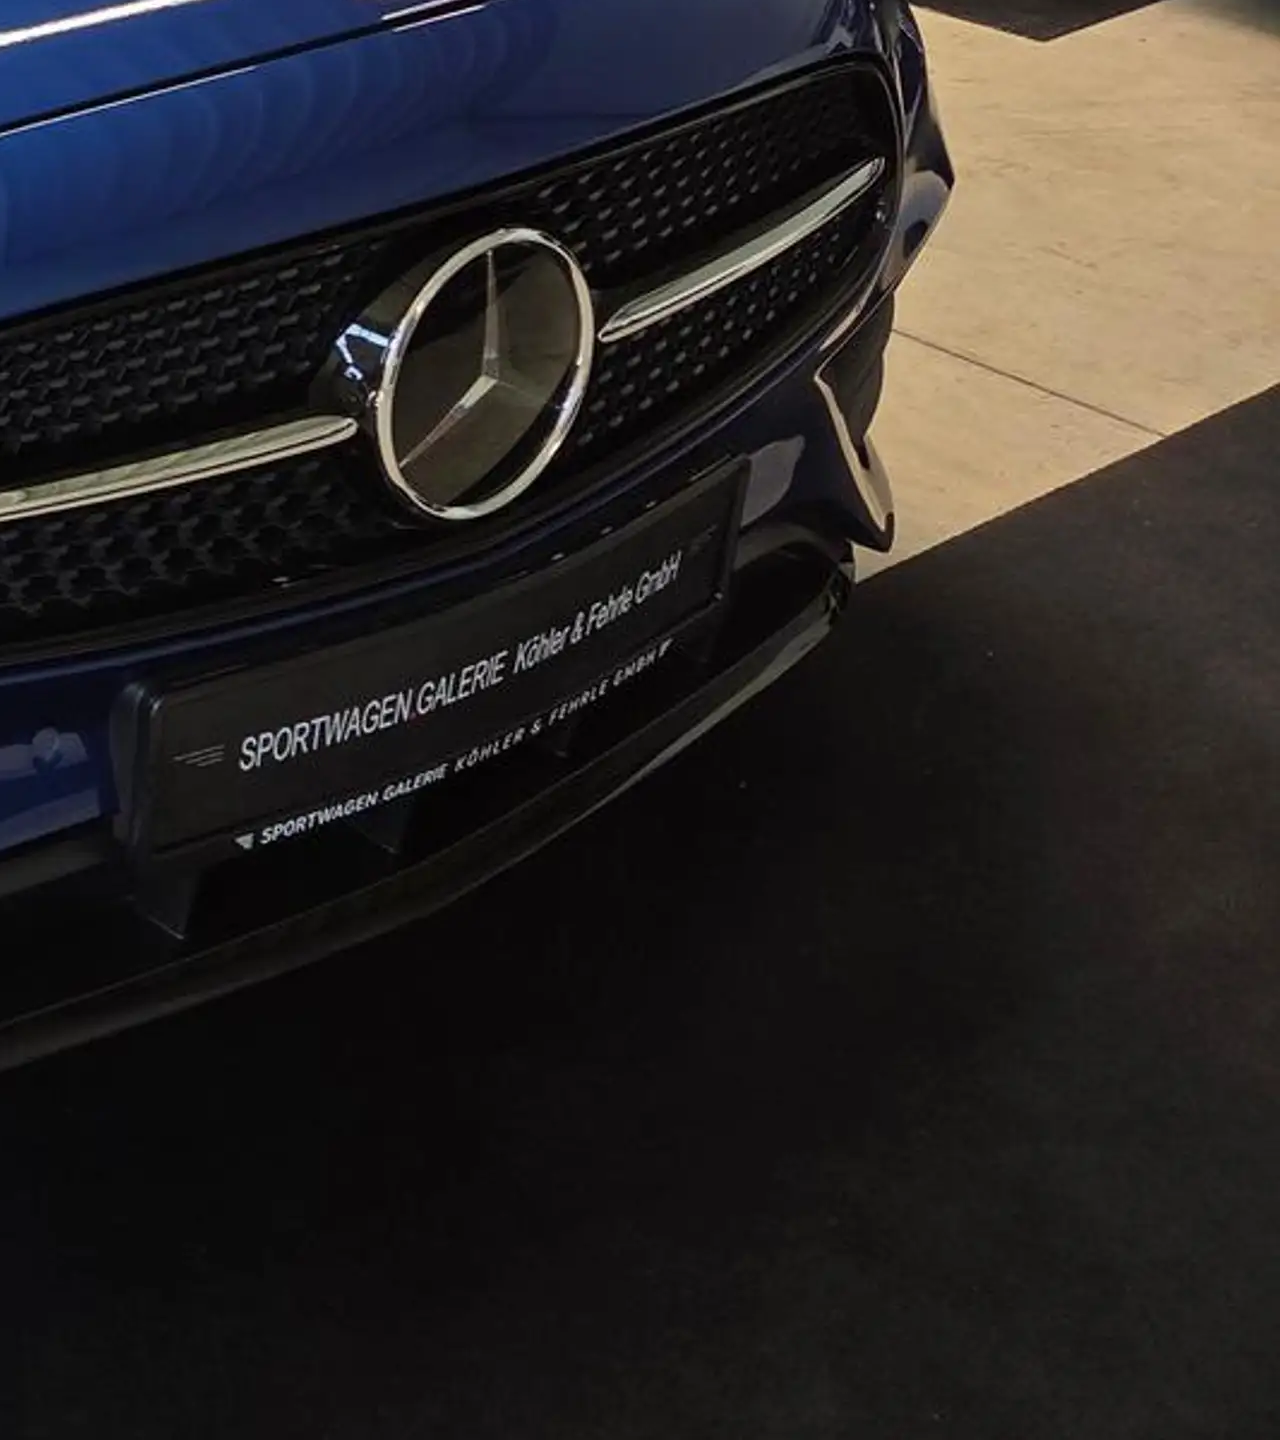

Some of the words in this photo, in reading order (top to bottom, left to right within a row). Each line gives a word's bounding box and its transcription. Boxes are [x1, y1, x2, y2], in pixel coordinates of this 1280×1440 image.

[513, 625, 570, 674] Köhler
[570, 612, 585, 644] &
[585, 586, 634, 636] Fehrle
[635, 550, 682, 604] GmbH
[382, 763, 449, 802] GALERIE
[454, 728, 525, 772] KÖHLER
[548, 679, 609, 725] FEHRLE
[613, 648, 656, 686] GMBH
